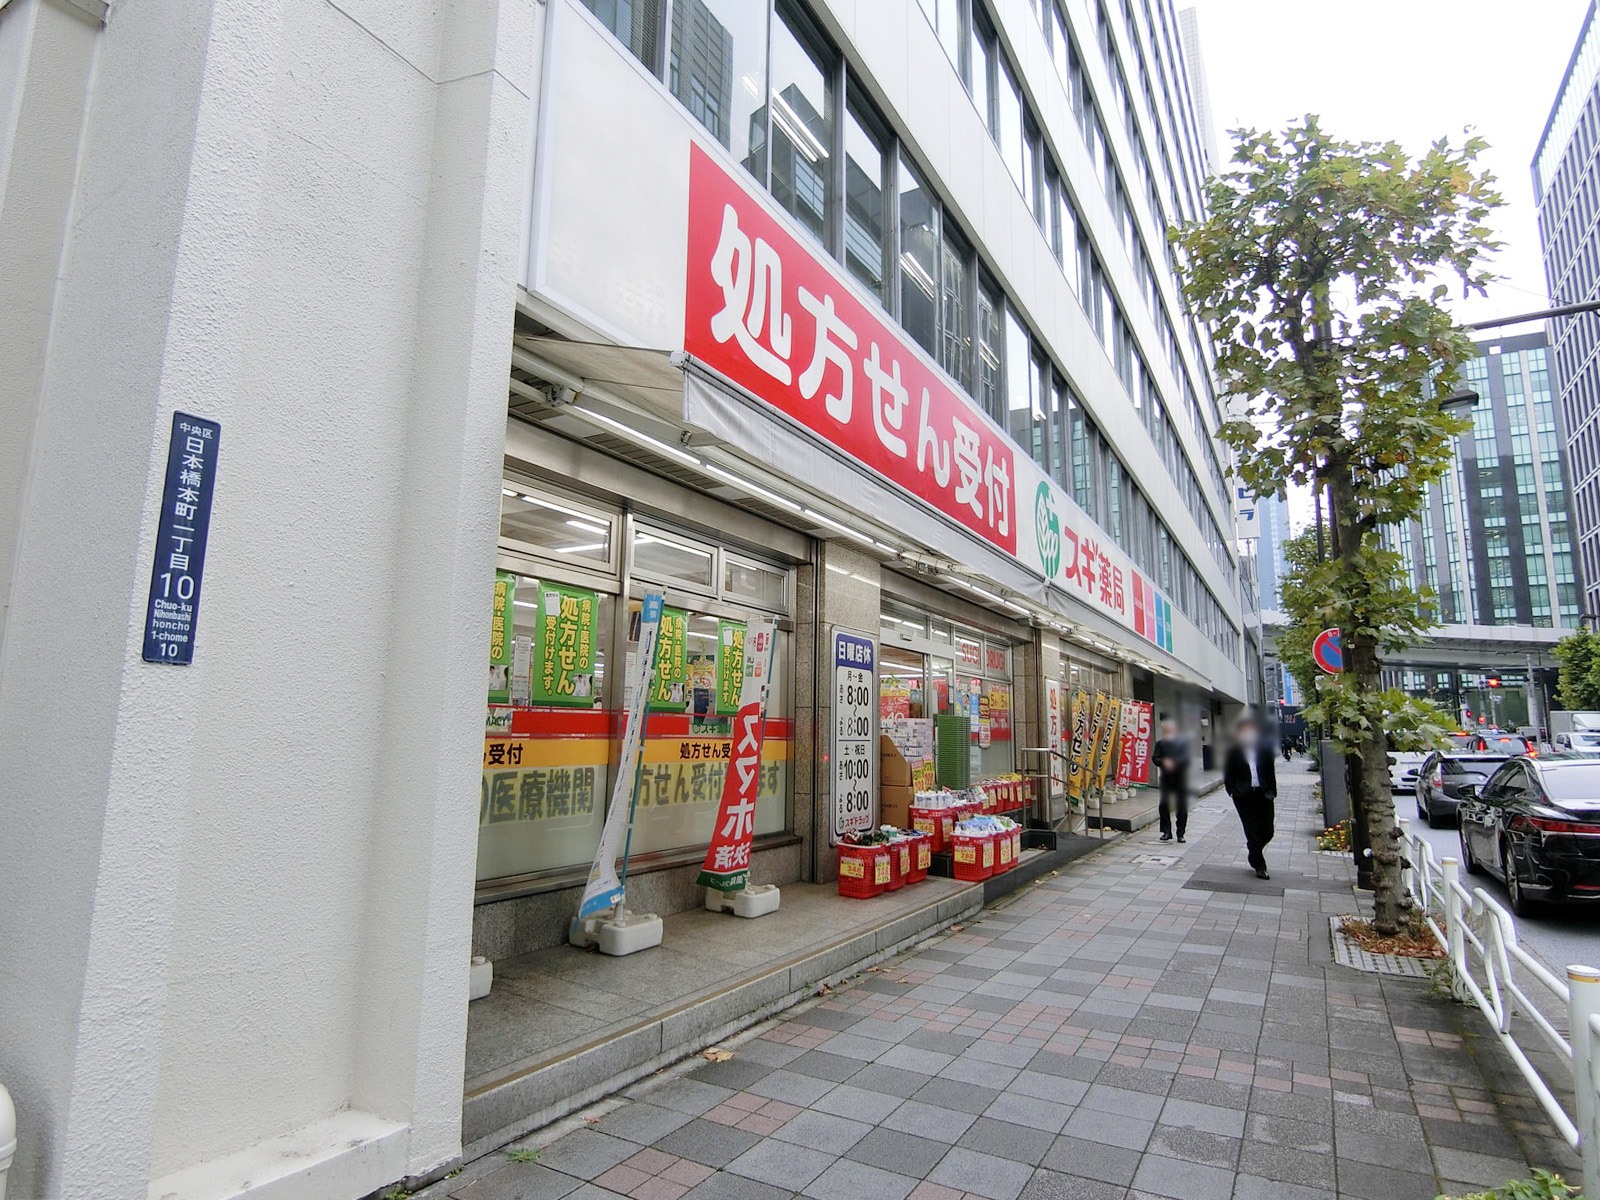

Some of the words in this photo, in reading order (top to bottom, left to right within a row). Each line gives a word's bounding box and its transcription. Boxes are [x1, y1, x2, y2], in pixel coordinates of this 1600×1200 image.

[710, 203, 1009, 537] 処方せん受付
[180, 422, 213, 439] 中央区
[169, 436, 205, 571] 日本橋本町一丁目
[1064, 525, 1125, 616] スギ薬局
[160, 572, 195, 600] 10
[153, 608, 192, 621] Nihonbashi
[154, 598, 192, 612] Chuo-ku
[153, 619, 190, 631] honcho
[151, 630, 188, 642] 1-chome
[557, 595, 579, 695] 処方せん
[159, 642, 178, 657] 10
[657, 615, 673, 702] 処方せん
[838, 641, 871, 664] 日曜店休
[847, 685, 869, 706] 8:00
[847, 716, 869, 737] 8:00
[483, 743, 523, 765] 受付
[844, 758, 869, 780] 10:00
[846, 791, 869, 812] 8:00
